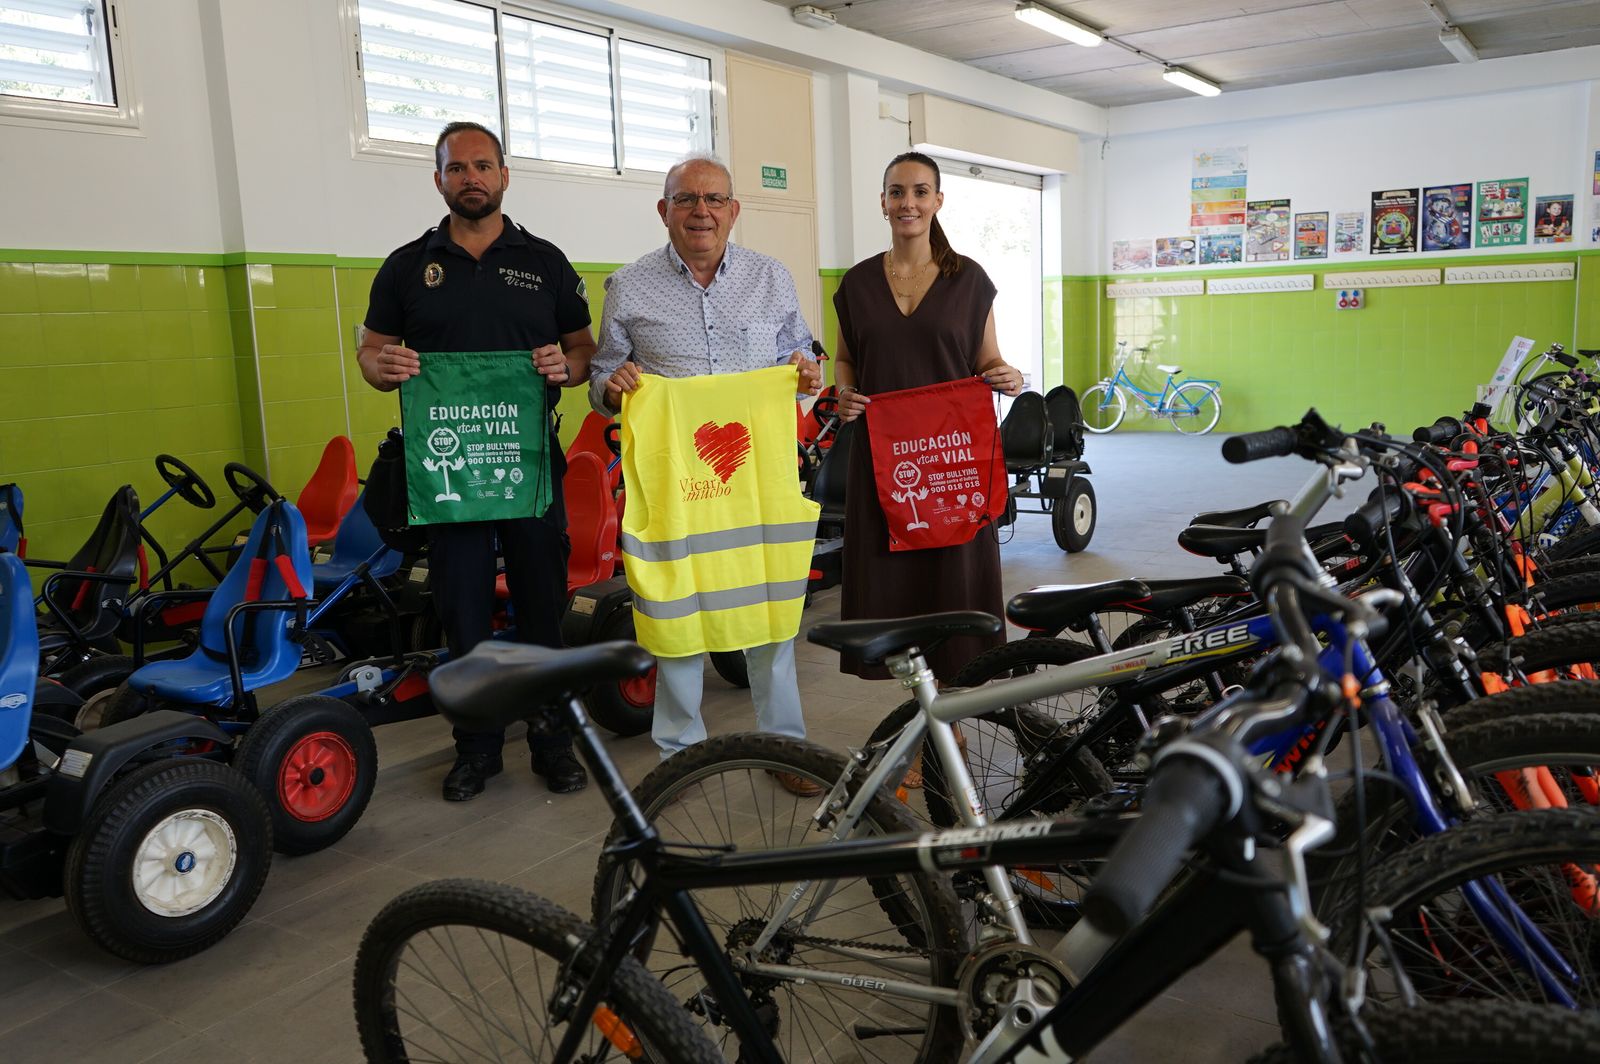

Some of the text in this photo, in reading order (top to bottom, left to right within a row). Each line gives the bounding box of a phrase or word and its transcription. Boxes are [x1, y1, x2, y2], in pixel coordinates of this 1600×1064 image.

[499, 267, 542, 283] POLICIA
[430, 401, 518, 420] EDUCACIÓN
[485, 421, 519, 435] VIAL
[434, 437, 454, 446] STOP
[467, 442, 520, 452] STOP BULLYING
[893, 430, 972, 455] EDUCACIÓN
[468, 457, 483, 465] 900
[486, 456, 502, 464] 018
[942, 448, 975, 464] VIAL
[898, 470, 916, 479] STOP
[928, 468, 977, 481] STOP BULLYING
[948, 483, 963, 491] 018
[965, 480, 980, 488] 018
[1170, 623, 1248, 656] FREE
